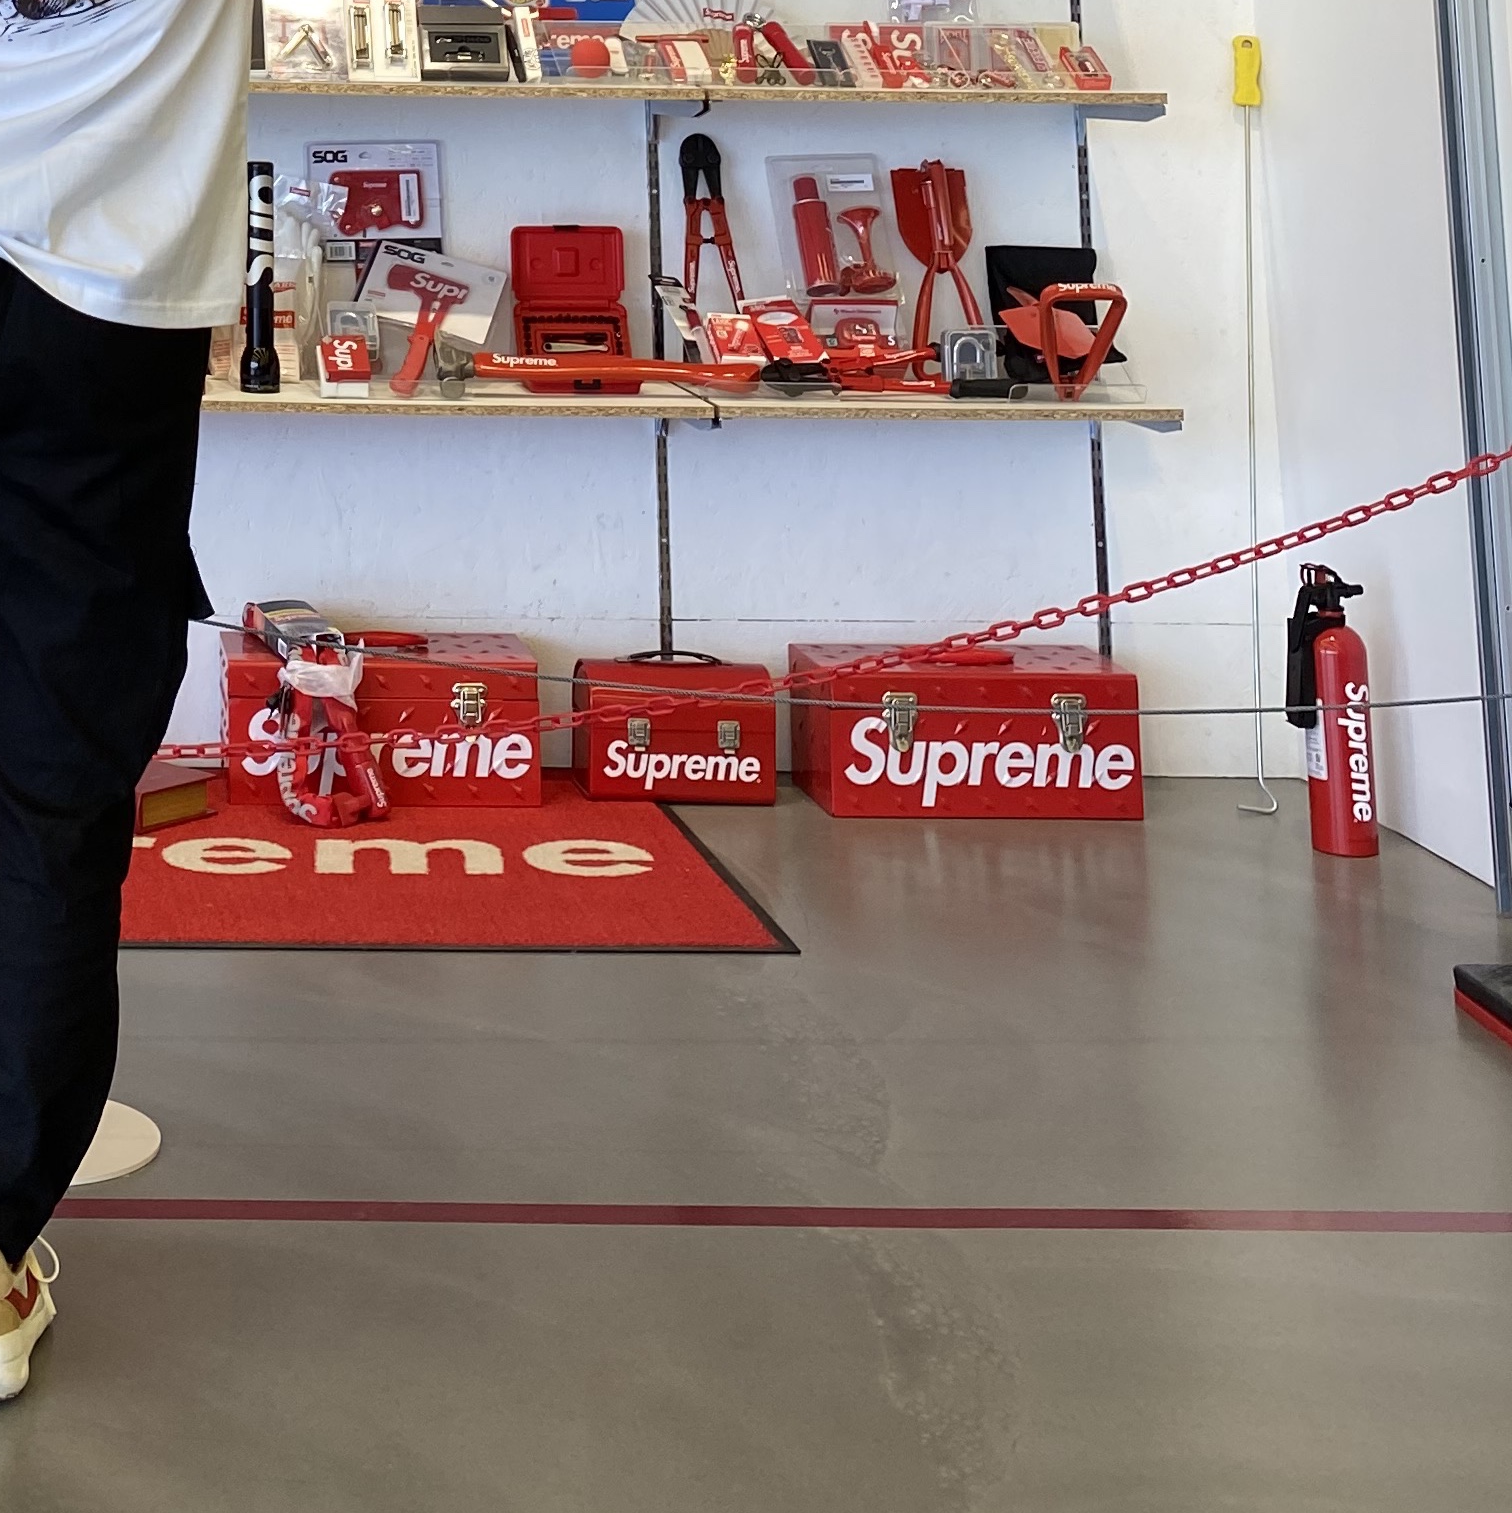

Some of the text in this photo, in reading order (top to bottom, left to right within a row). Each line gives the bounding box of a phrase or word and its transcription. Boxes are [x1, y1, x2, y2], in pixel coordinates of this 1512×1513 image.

[312, 150, 348, 164] SOG
[382, 244, 426, 265] SOG
[603, 739, 758, 790] Supreme
[844, 715, 1136, 807] Supreme
[1336, 681, 1373, 823] Supreme
